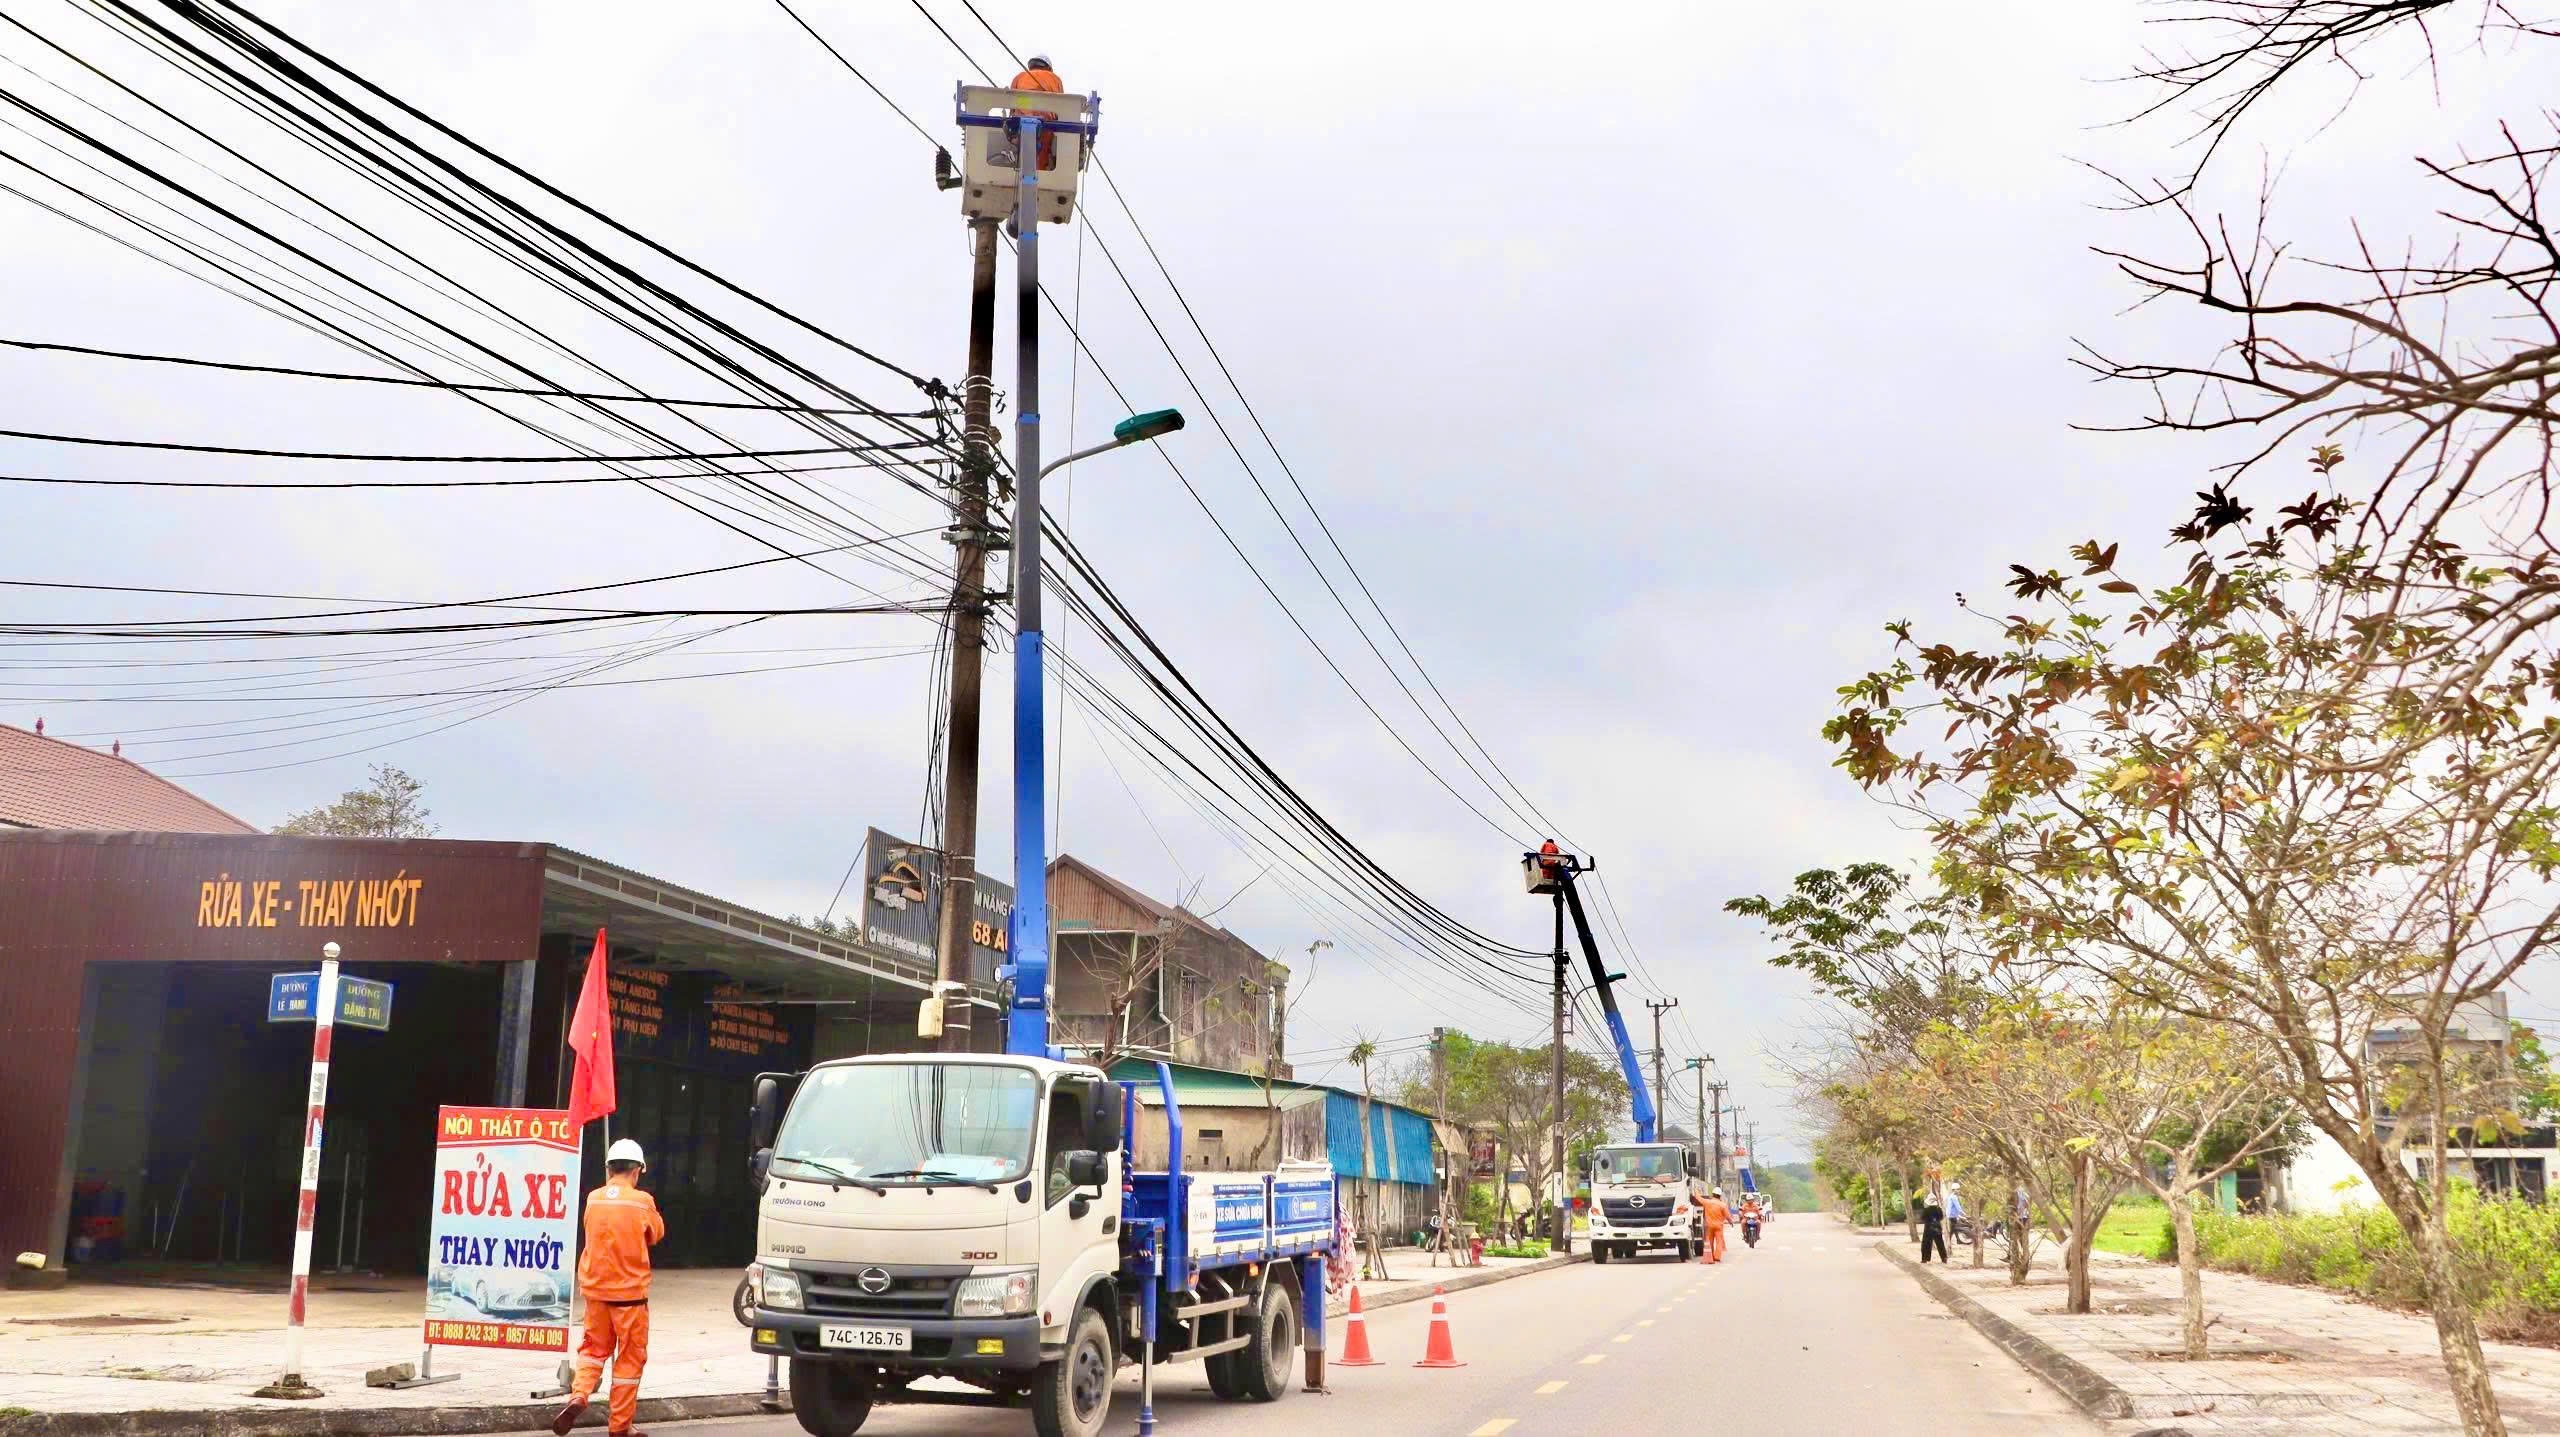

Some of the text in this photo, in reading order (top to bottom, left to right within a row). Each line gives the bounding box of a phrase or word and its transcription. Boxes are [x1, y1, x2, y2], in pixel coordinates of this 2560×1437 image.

[198, 873, 242, 927] RỬA
[247, 881, 281, 927] XE
[299, 880, 354, 927] THAY
[355, 869, 422, 927] NHỚT
[972, 920, 991, 946] 68
[445, 1114, 473, 1139] NỘI
[480, 1113, 524, 1137] THẤT
[530, 1117, 542, 1138] Ô
[441, 1152, 567, 1219] RỬA XE
[803, 1199, 826, 1208] LONG
[1216, 1206, 1225, 1222] XE
[440, 1231, 563, 1270] THAY NHỚT
[771, 1243, 806, 1255] HINO
[961, 1251, 998, 1260] 300
[443, 1323, 463, 1339] 0888
[465, 1324, 481, 1341] 242
[482, 1325, 498, 1342] 339
[506, 1326, 526, 1343] 0857
[529, 1328, 544, 1344] 846
[547, 1329, 562, 1346] 009
